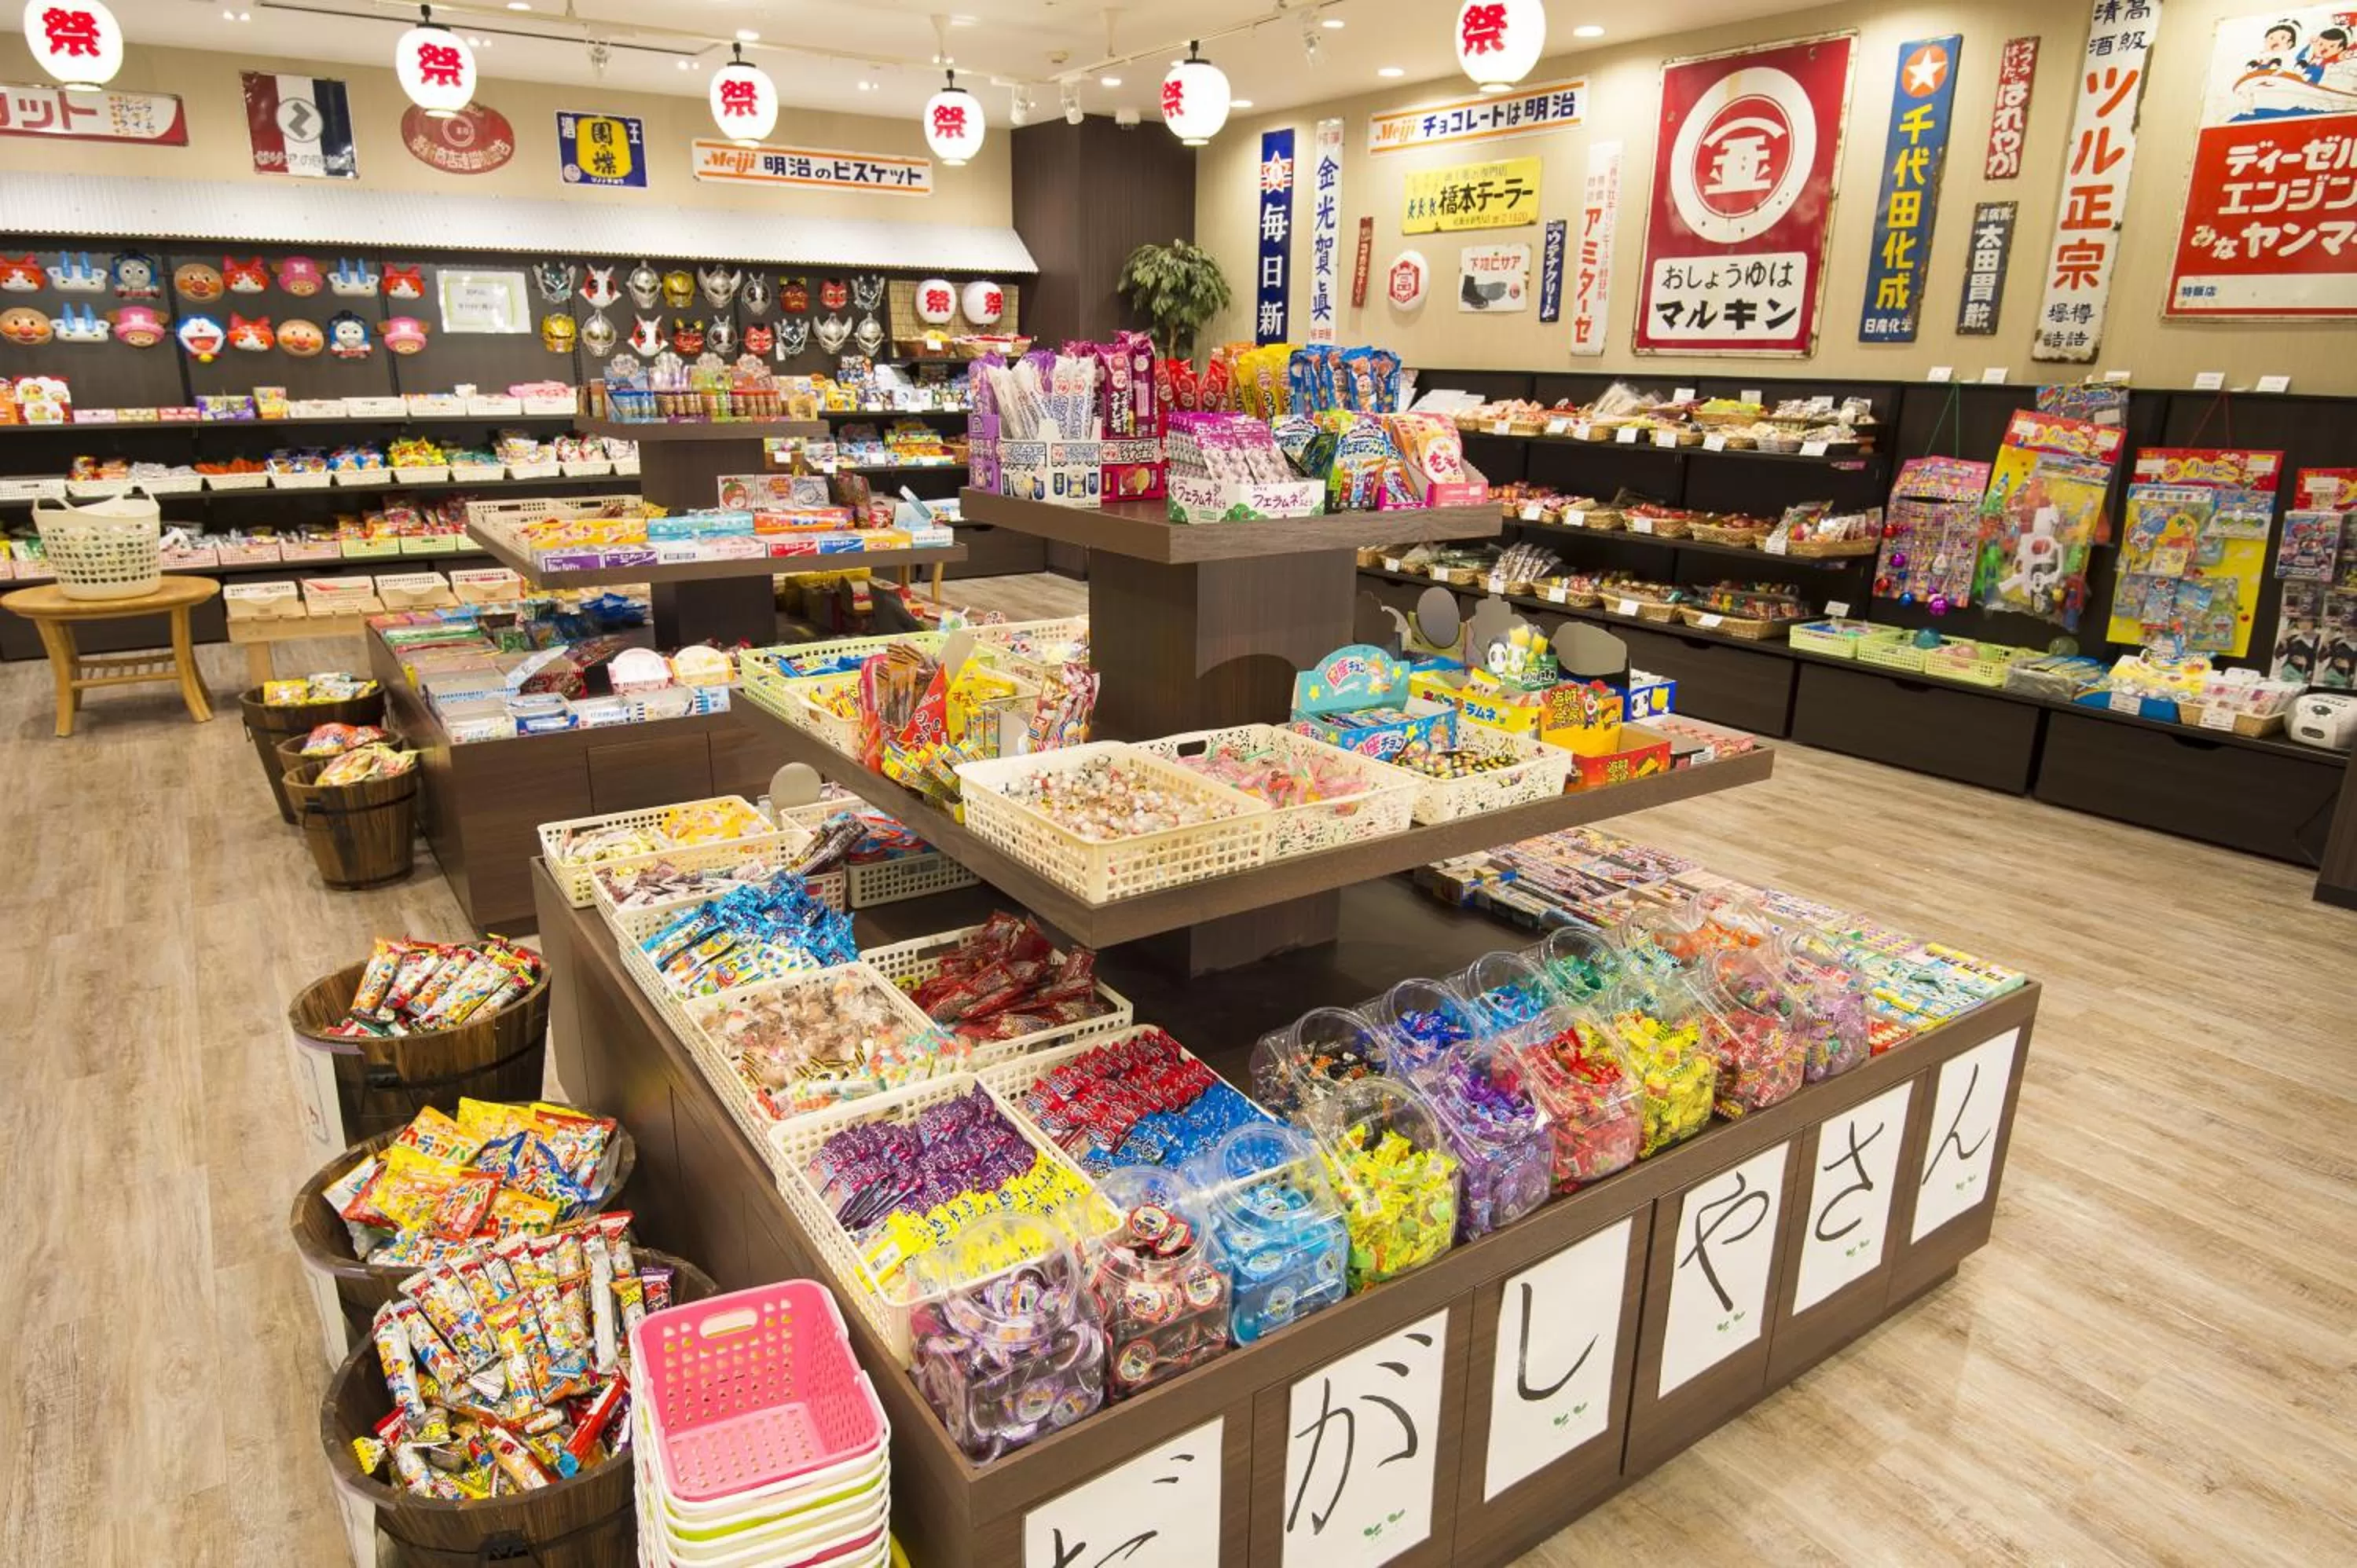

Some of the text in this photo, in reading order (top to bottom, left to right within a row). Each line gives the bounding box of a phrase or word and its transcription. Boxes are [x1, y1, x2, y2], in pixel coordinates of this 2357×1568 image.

[42, 7, 101, 57] 祭
[1462, 3, 1509, 57] 祭
[417, 42, 463, 87] 祭
[0, 90, 97, 130] ット
[720, 79, 759, 117] 祭
[1161, 79, 1185, 118] 祭
[1423, 91, 1576, 137] チョコレートは明治
[933, 104, 968, 139] 祭
[1375, 118, 1417, 143] Meiji
[1987, 81, 2029, 177] はれやか
[704, 149, 757, 175] Meiji
[763, 155, 923, 187] 明治のビスケット
[2225, 134, 2357, 177] ディーゼル
[1439, 178, 1534, 216] 橋本テーラー
[2053, 65, 2139, 291] ツル正宗
[2217, 174, 2357, 215] エンジン
[1875, 102, 1935, 310] 千代田化成
[1541, 231, 1561, 319] ウテナクリーム
[1574, 208, 1603, 343] アミターゼ
[1662, 261, 1794, 290] おしょうゆは
[926, 288, 950, 313] 祭
[1655, 298, 1798, 331] マルキン
[1178, 485, 1214, 507] フェラムネ
[1252, 493, 1299, 508] フェラムネ
